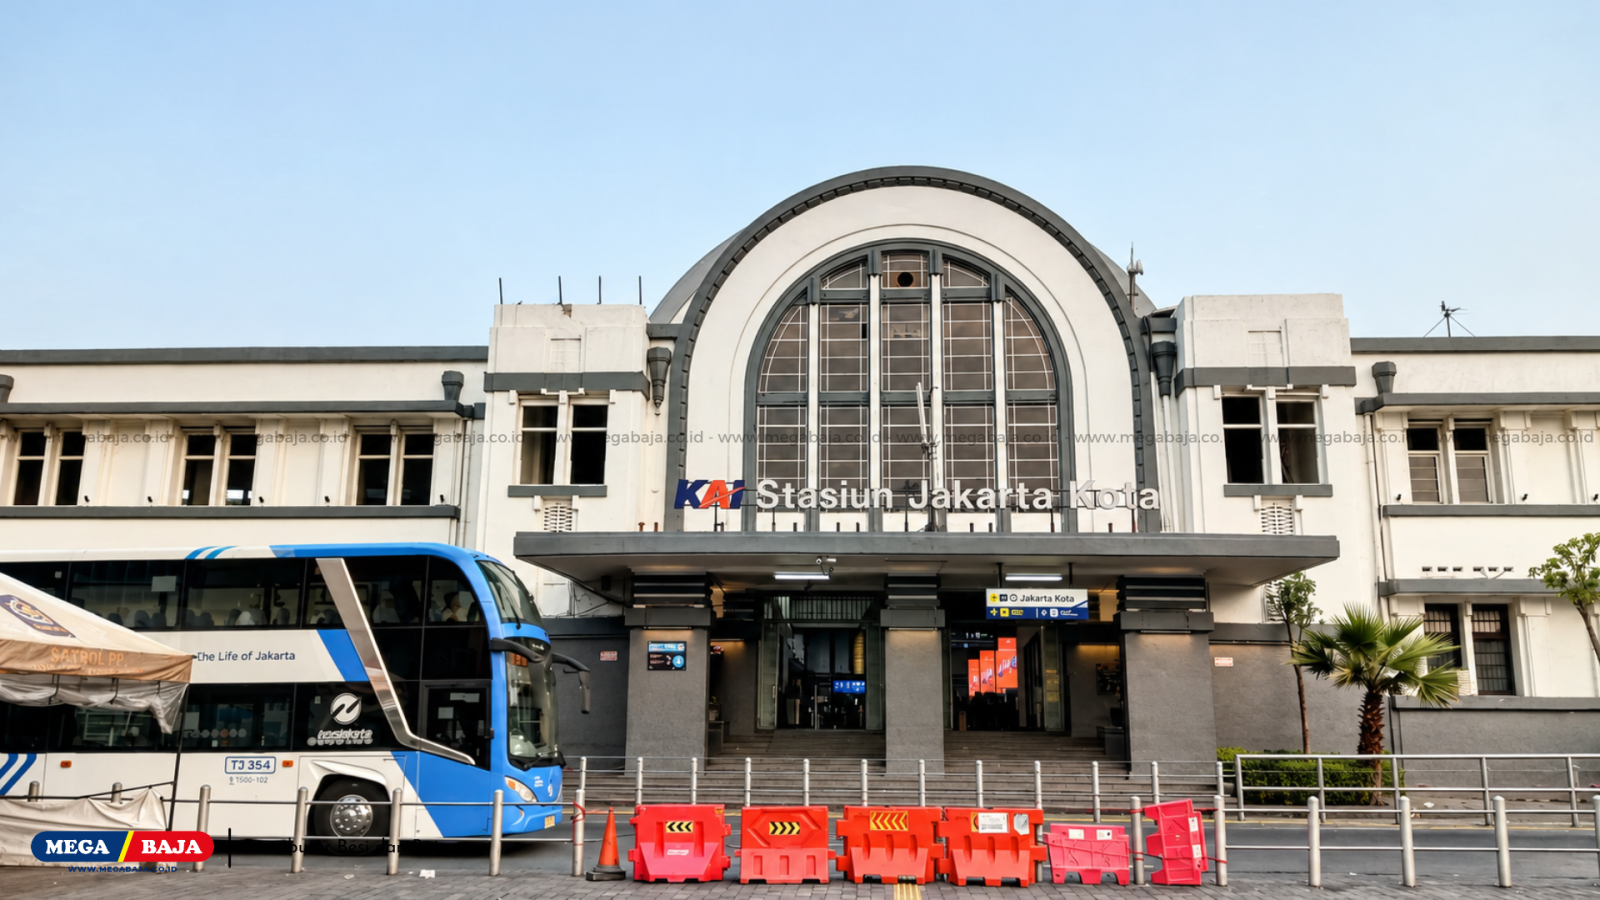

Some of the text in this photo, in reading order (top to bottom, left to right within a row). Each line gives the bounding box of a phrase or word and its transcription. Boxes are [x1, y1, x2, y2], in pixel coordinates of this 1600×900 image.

[674, 479, 1160, 510] KAI Stasiun Jakarta Kota
[218, 651, 239, 661] Life
[241, 651, 253, 660] of
[255, 651, 296, 660] Jakarta
[231, 760, 271, 770] TJ 354
